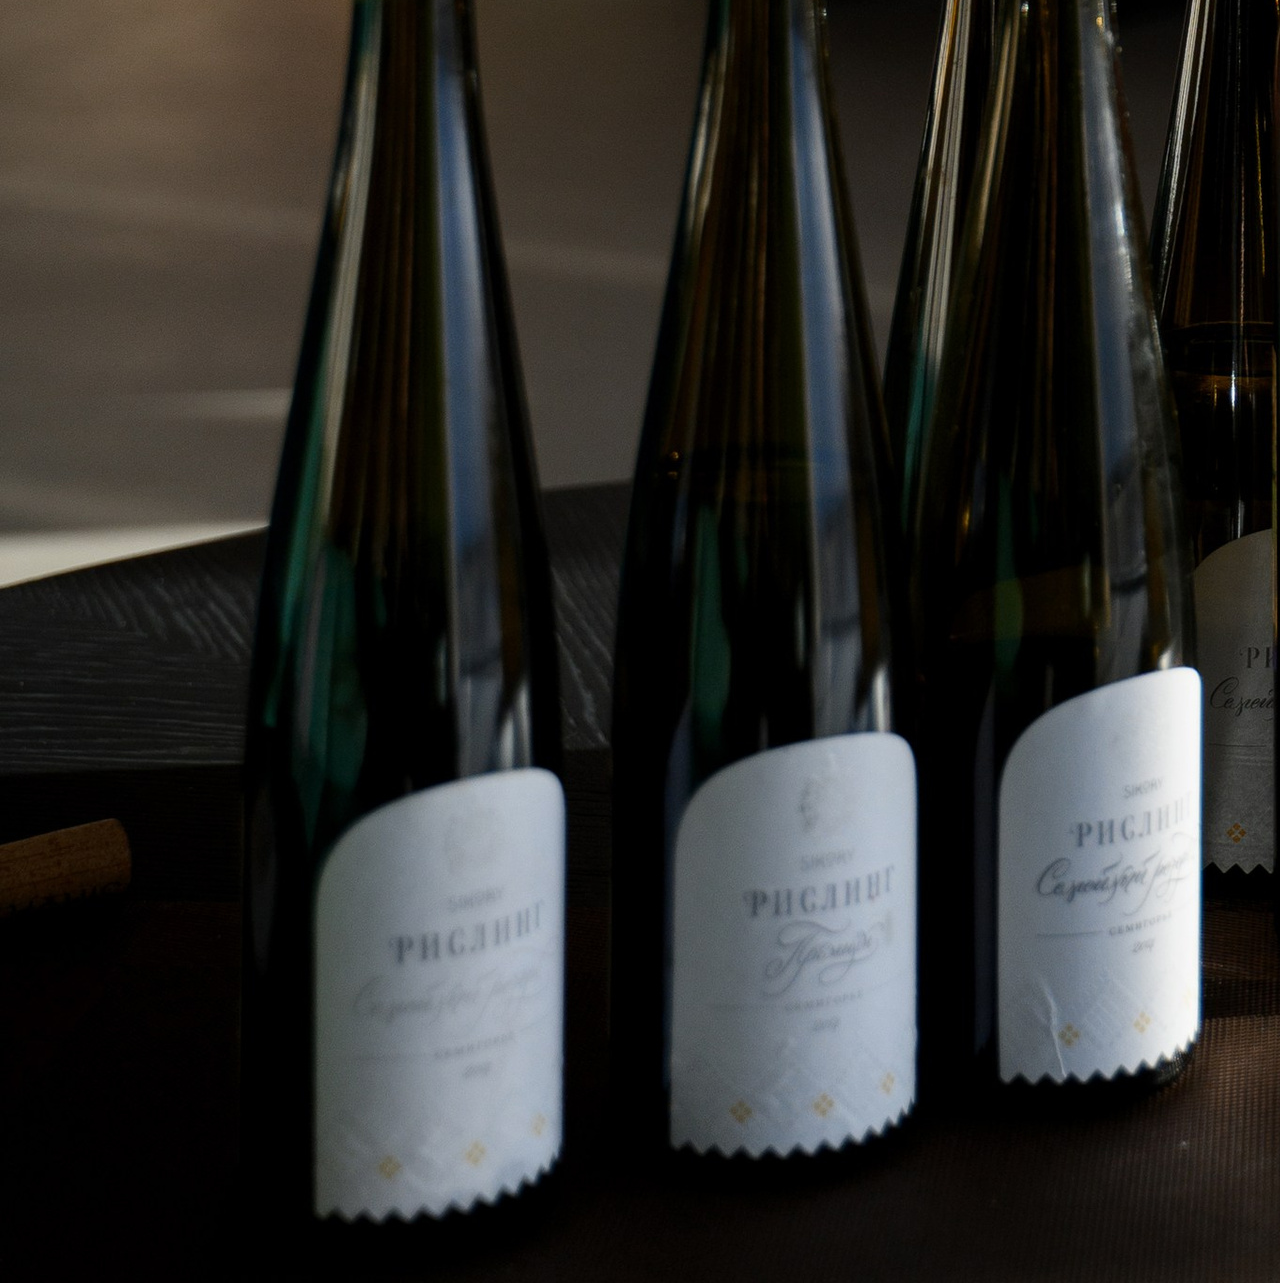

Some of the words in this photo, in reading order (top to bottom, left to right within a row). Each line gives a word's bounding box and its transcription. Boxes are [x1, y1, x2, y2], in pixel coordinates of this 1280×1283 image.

[1069, 791, 1192, 848] РИСЛИНГ
[742, 865, 895, 918] РИСЛИНГ
[388, 899, 545, 965] РИСЛИНГ
